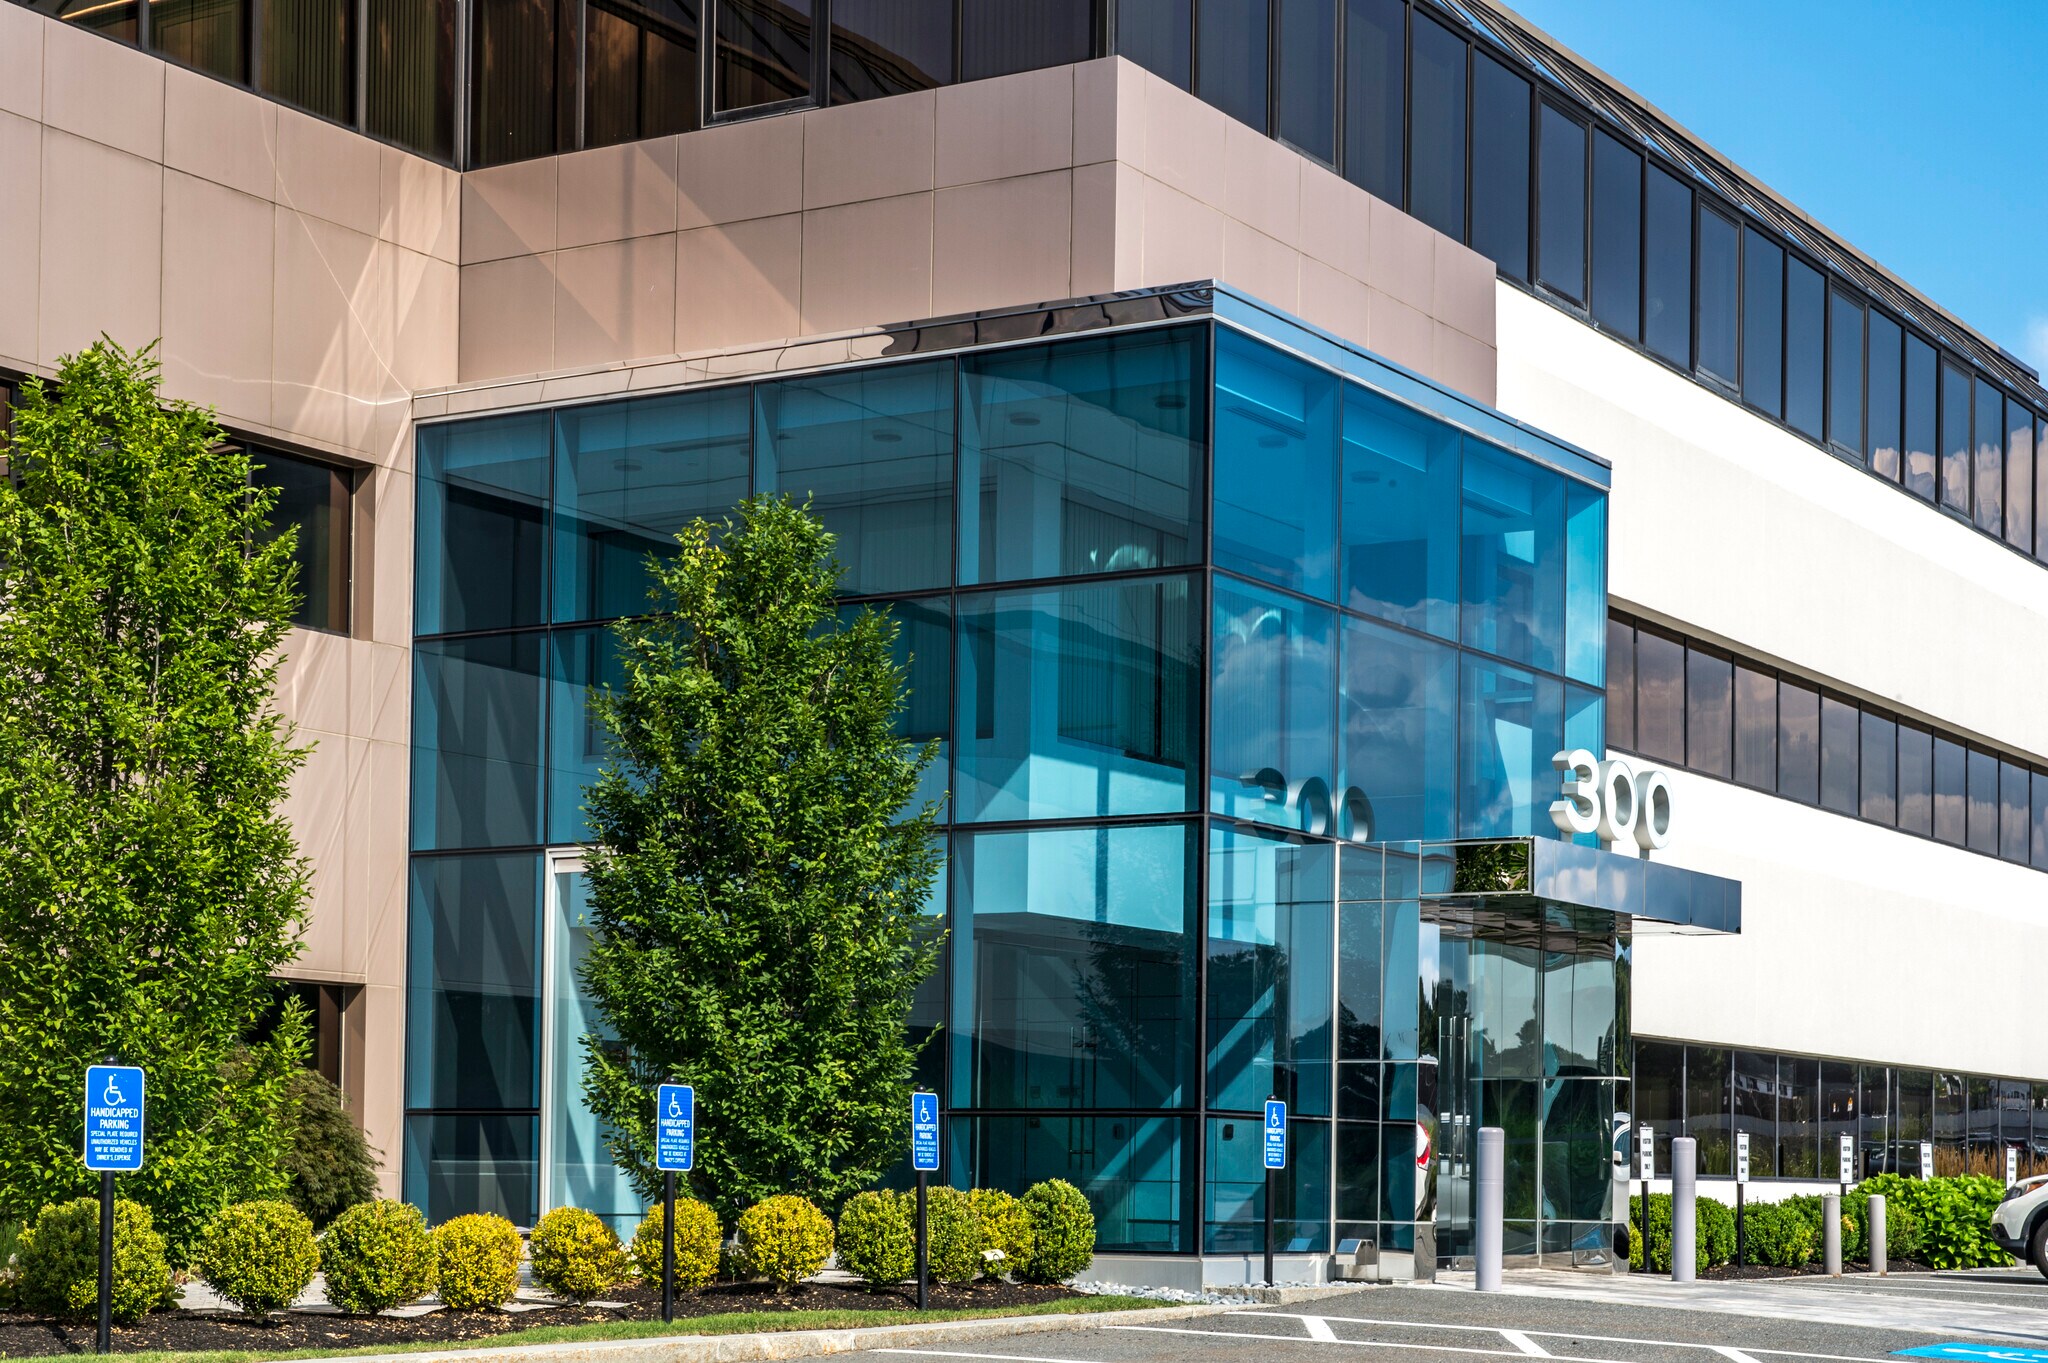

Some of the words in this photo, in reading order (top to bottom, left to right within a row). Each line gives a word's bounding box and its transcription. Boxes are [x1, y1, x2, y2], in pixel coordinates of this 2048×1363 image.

[1549, 748, 1672, 850] 300
[90, 1107, 139, 1118] HANDICAPPED
[99, 1119, 129, 1129] PARKING
[660, 1118, 690, 1128] HANDICAPPED
